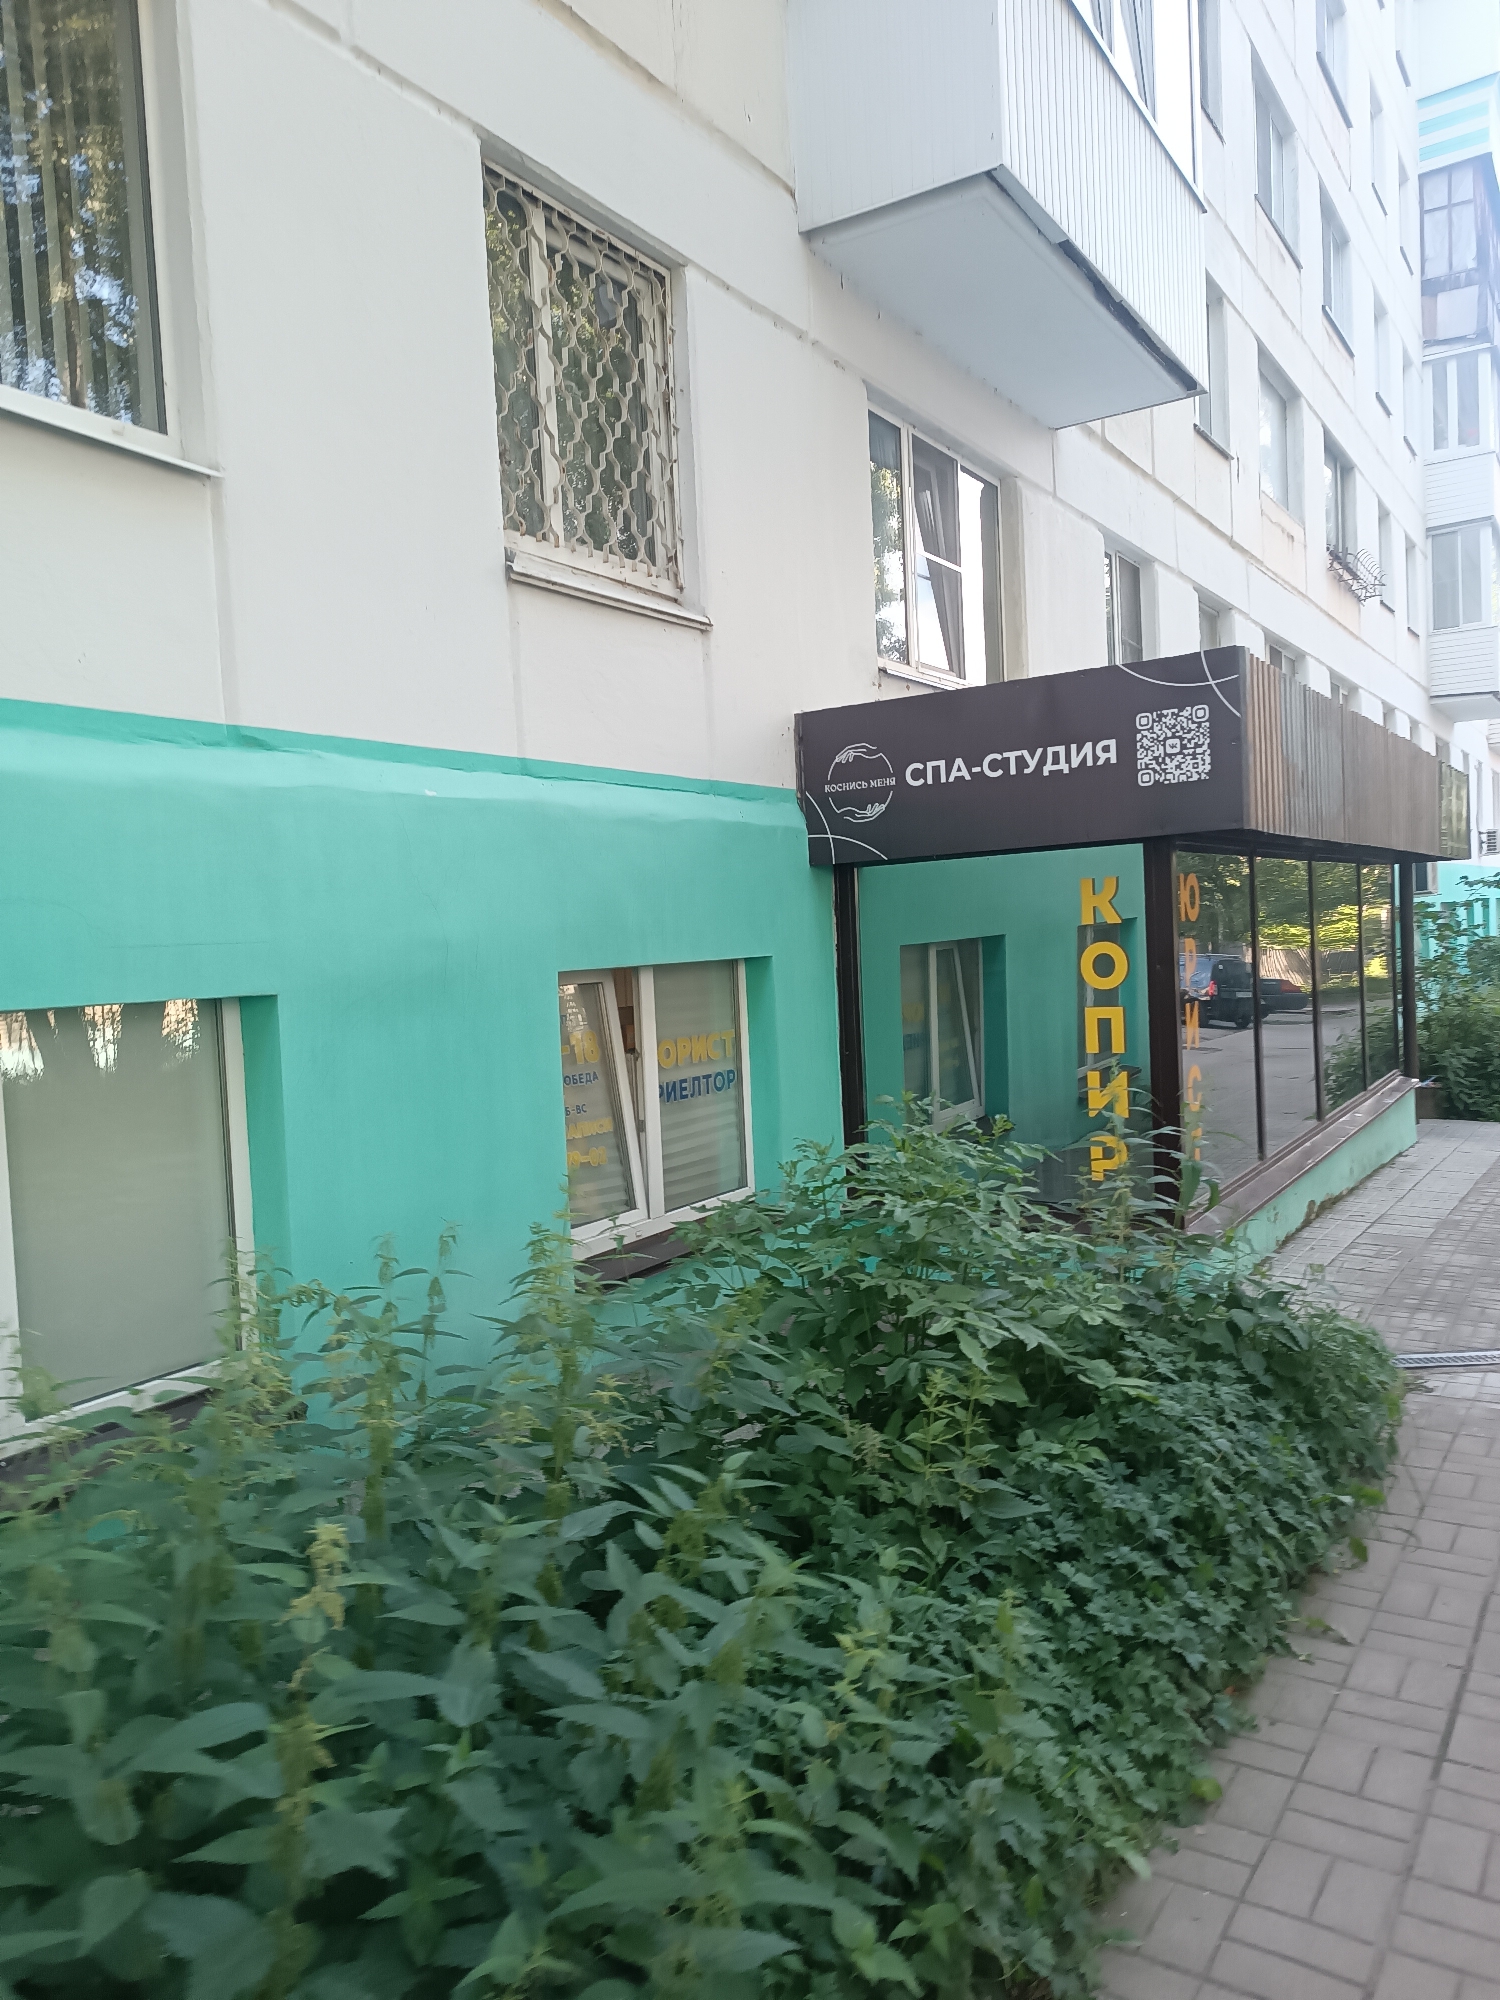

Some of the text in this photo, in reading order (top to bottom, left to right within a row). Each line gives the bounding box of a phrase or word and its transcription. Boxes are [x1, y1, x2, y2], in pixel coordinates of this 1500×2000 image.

[824, 777, 896, 793] КОСНИСЬ МЕНЯ
[905, 738, 1118, 787] СПА-СТУДИЯ
[1080, 876, 1129, 1181] КОПИР
